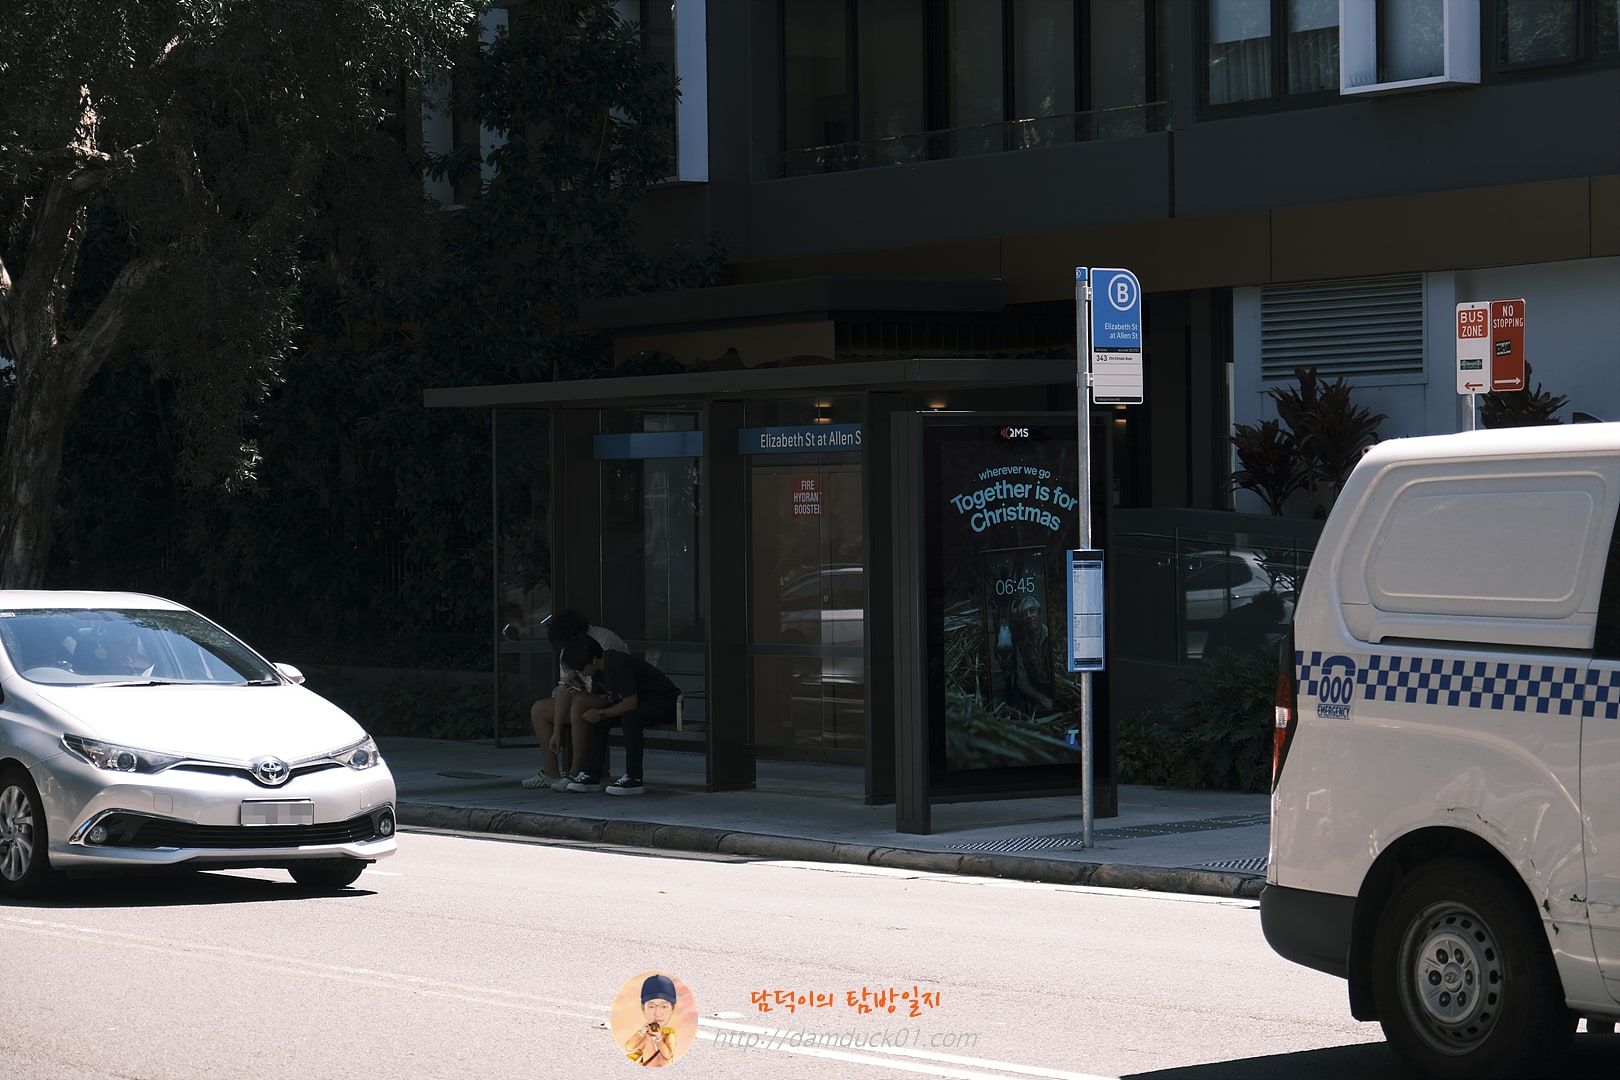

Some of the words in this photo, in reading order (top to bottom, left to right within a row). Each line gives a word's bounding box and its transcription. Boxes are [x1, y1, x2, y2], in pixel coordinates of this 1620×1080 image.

[1117, 282, 1129, 303] B
[1460, 311, 1484, 323] BUS
[1502, 305, 1514, 317] NO
[1104, 322, 1131, 331] Elizabeth
[1131, 323, 1138, 331] St
[1493, 318, 1524, 328] STOPPING
[1116, 332, 1131, 340] Allen
[1461, 326, 1483, 337] ZONE
[1096, 354, 1108, 362] 343
[760, 432, 803, 448] Elizabeth
[805, 433, 816, 447] St
[817, 434, 827, 447] at
[828, 431, 854, 446] Allen
[855, 430, 862, 445] S
[978, 466, 1022, 480] wherever
[1024, 466, 1037, 476] we
[1038, 467, 1051, 480] go
[801, 480, 815, 490] FIRE
[793, 492, 822, 502] HYDRAN
[950, 480, 1032, 514] Together
[1035, 481, 1050, 501] is
[1053, 486, 1078, 512] for
[970, 503, 1061, 533] Christmas
[995, 577, 1035, 595] 06:45
[1319, 676, 1353, 704] 000
[1317, 704, 1350, 719] EMERGENCY
